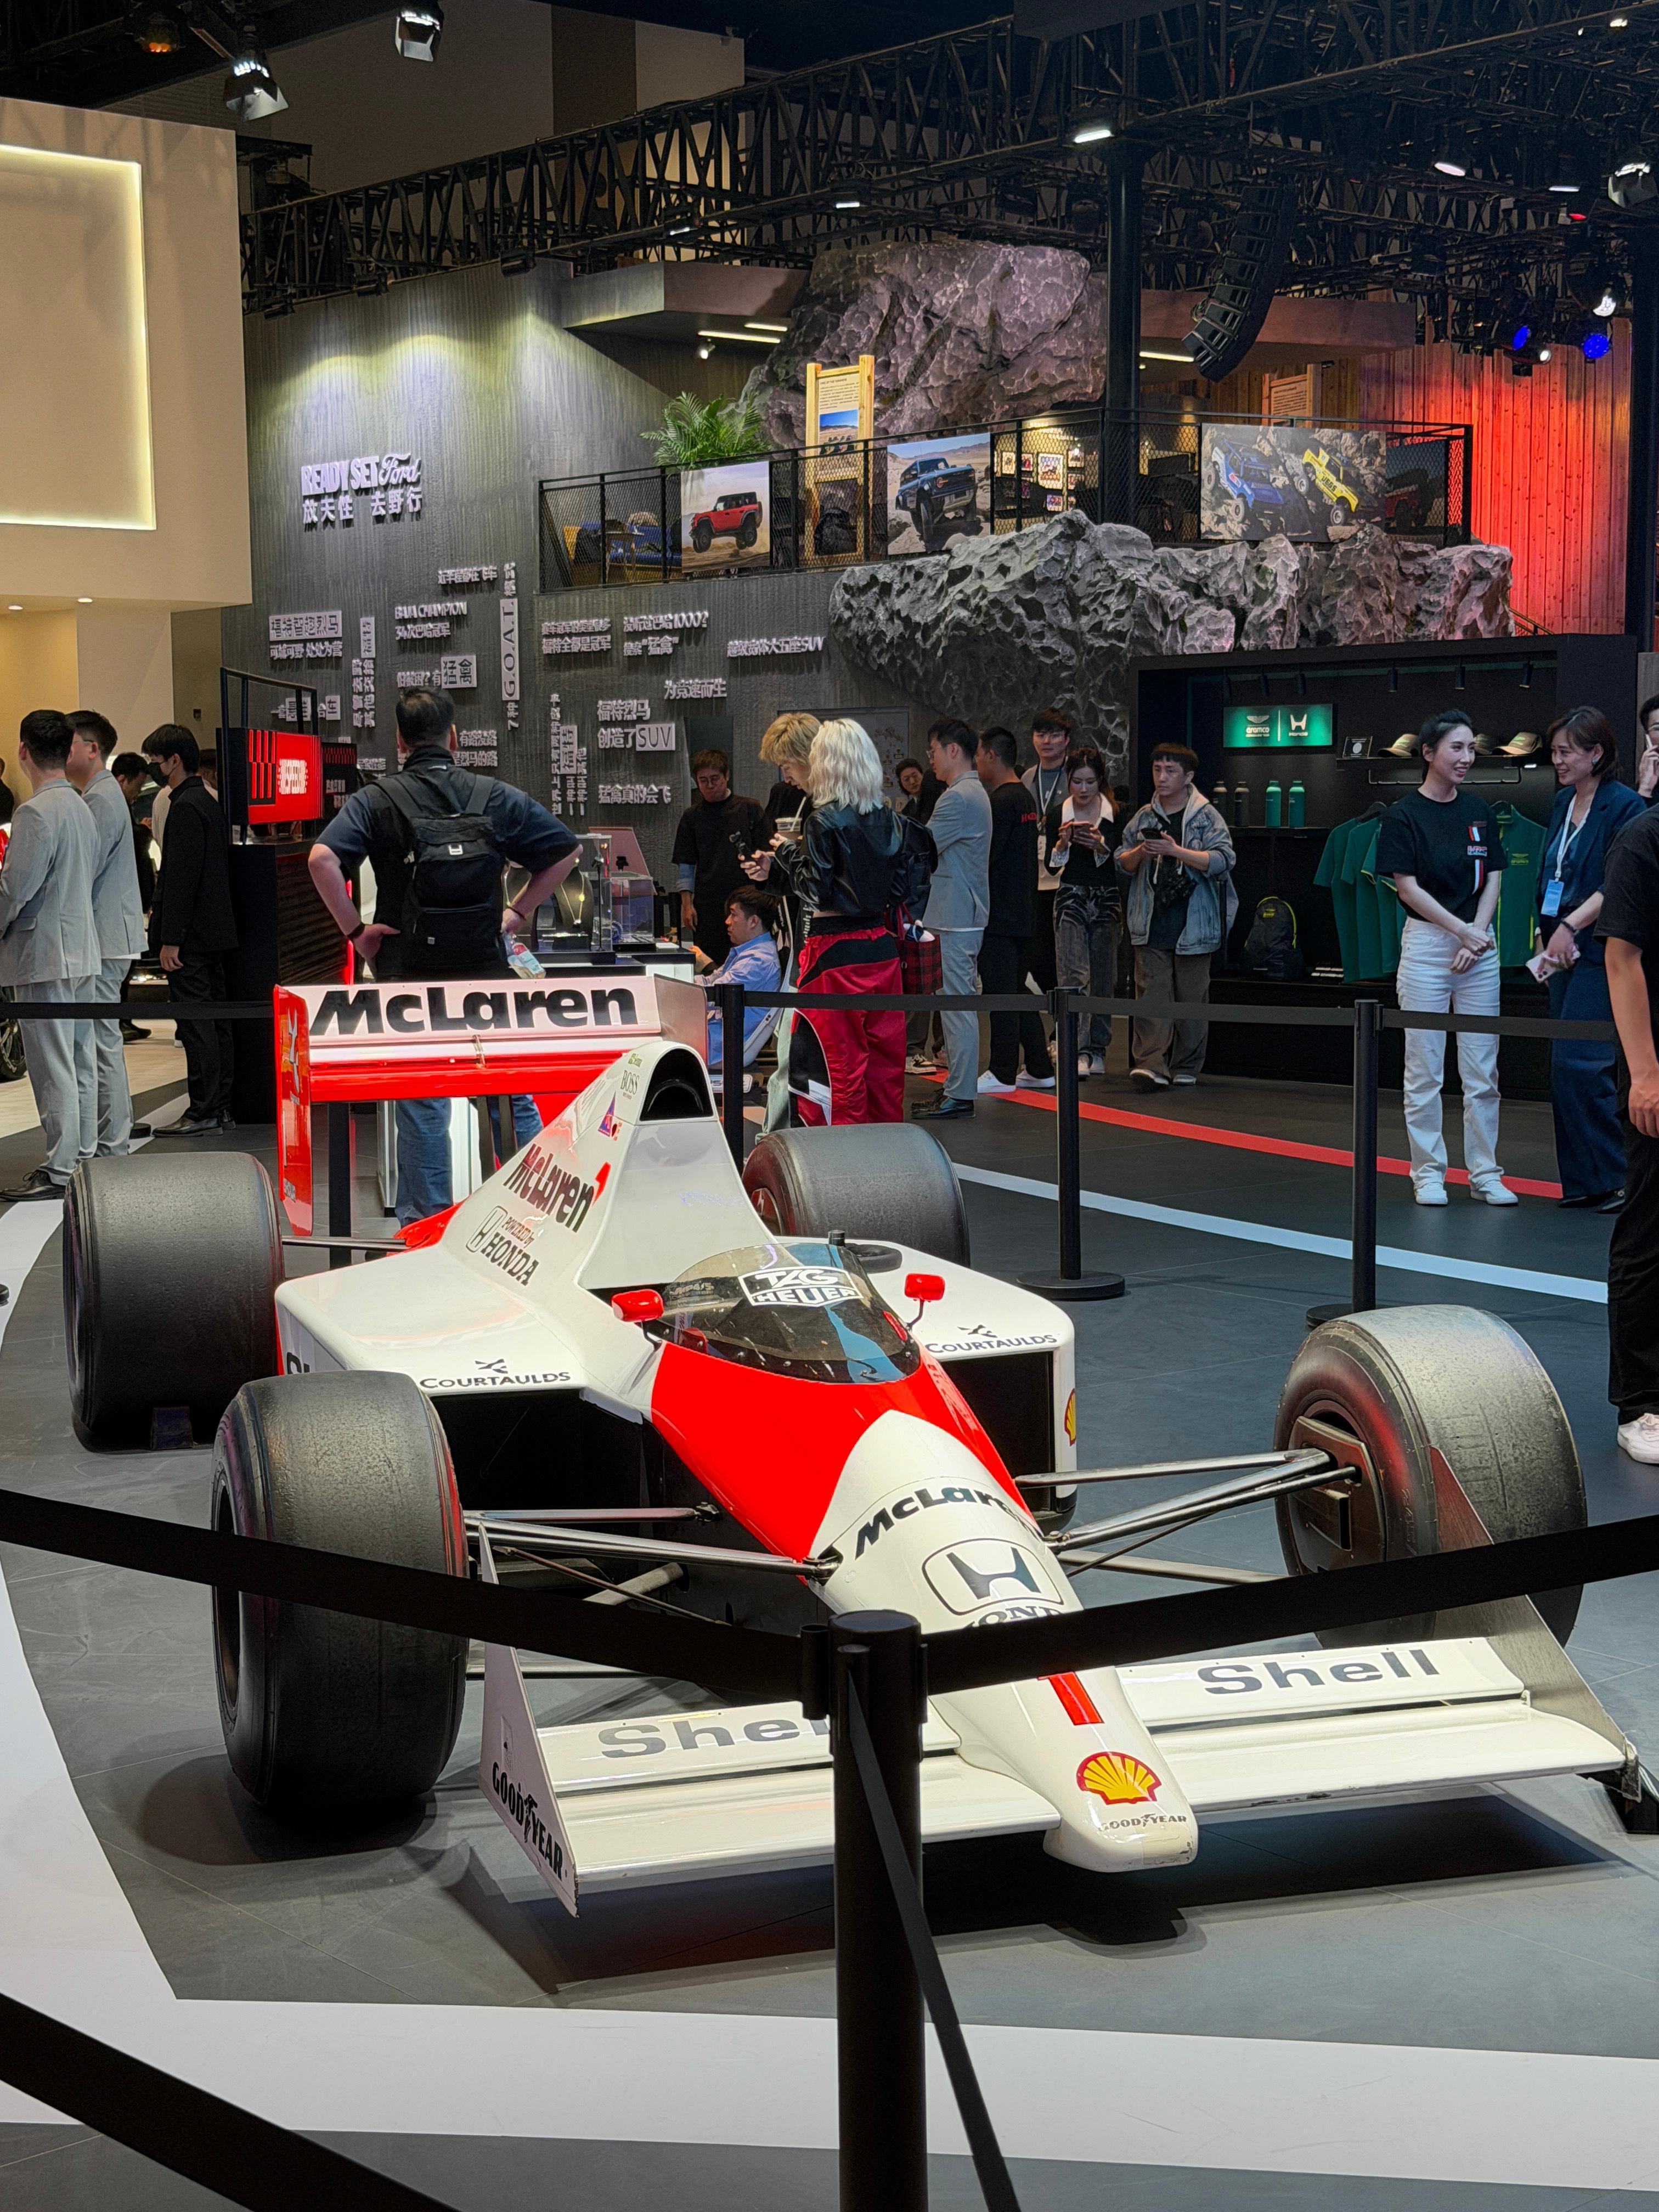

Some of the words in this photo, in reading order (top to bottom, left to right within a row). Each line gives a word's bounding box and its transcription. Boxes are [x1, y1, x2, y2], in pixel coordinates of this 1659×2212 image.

[301, 459, 350, 496] READY
[350, 455, 379, 490] SET
[379, 452, 422, 486] Ford
[417, 601, 467, 618] CHAMPION
[596, 698, 651, 722] 福特烈马
[597, 783, 672, 805] 猛禽真的会飞
[309, 985, 640, 1036] McLaren
[620, 1069, 640, 1095] BOSS
[503, 1143, 595, 1233] McLaren
[503, 1216, 529, 1242] POWERED
[481, 1231, 539, 1287] HONDA
[754, 1269, 838, 1289] TAG
[757, 1287, 857, 1304] HEUER
[925, 1334, 1058, 1354] COURTAULDS
[419, 1371, 572, 1389] COURTAULDS
[1197, 1649, 1441, 1695] Shell
[492, 1760, 564, 1882] GOODYEAR
